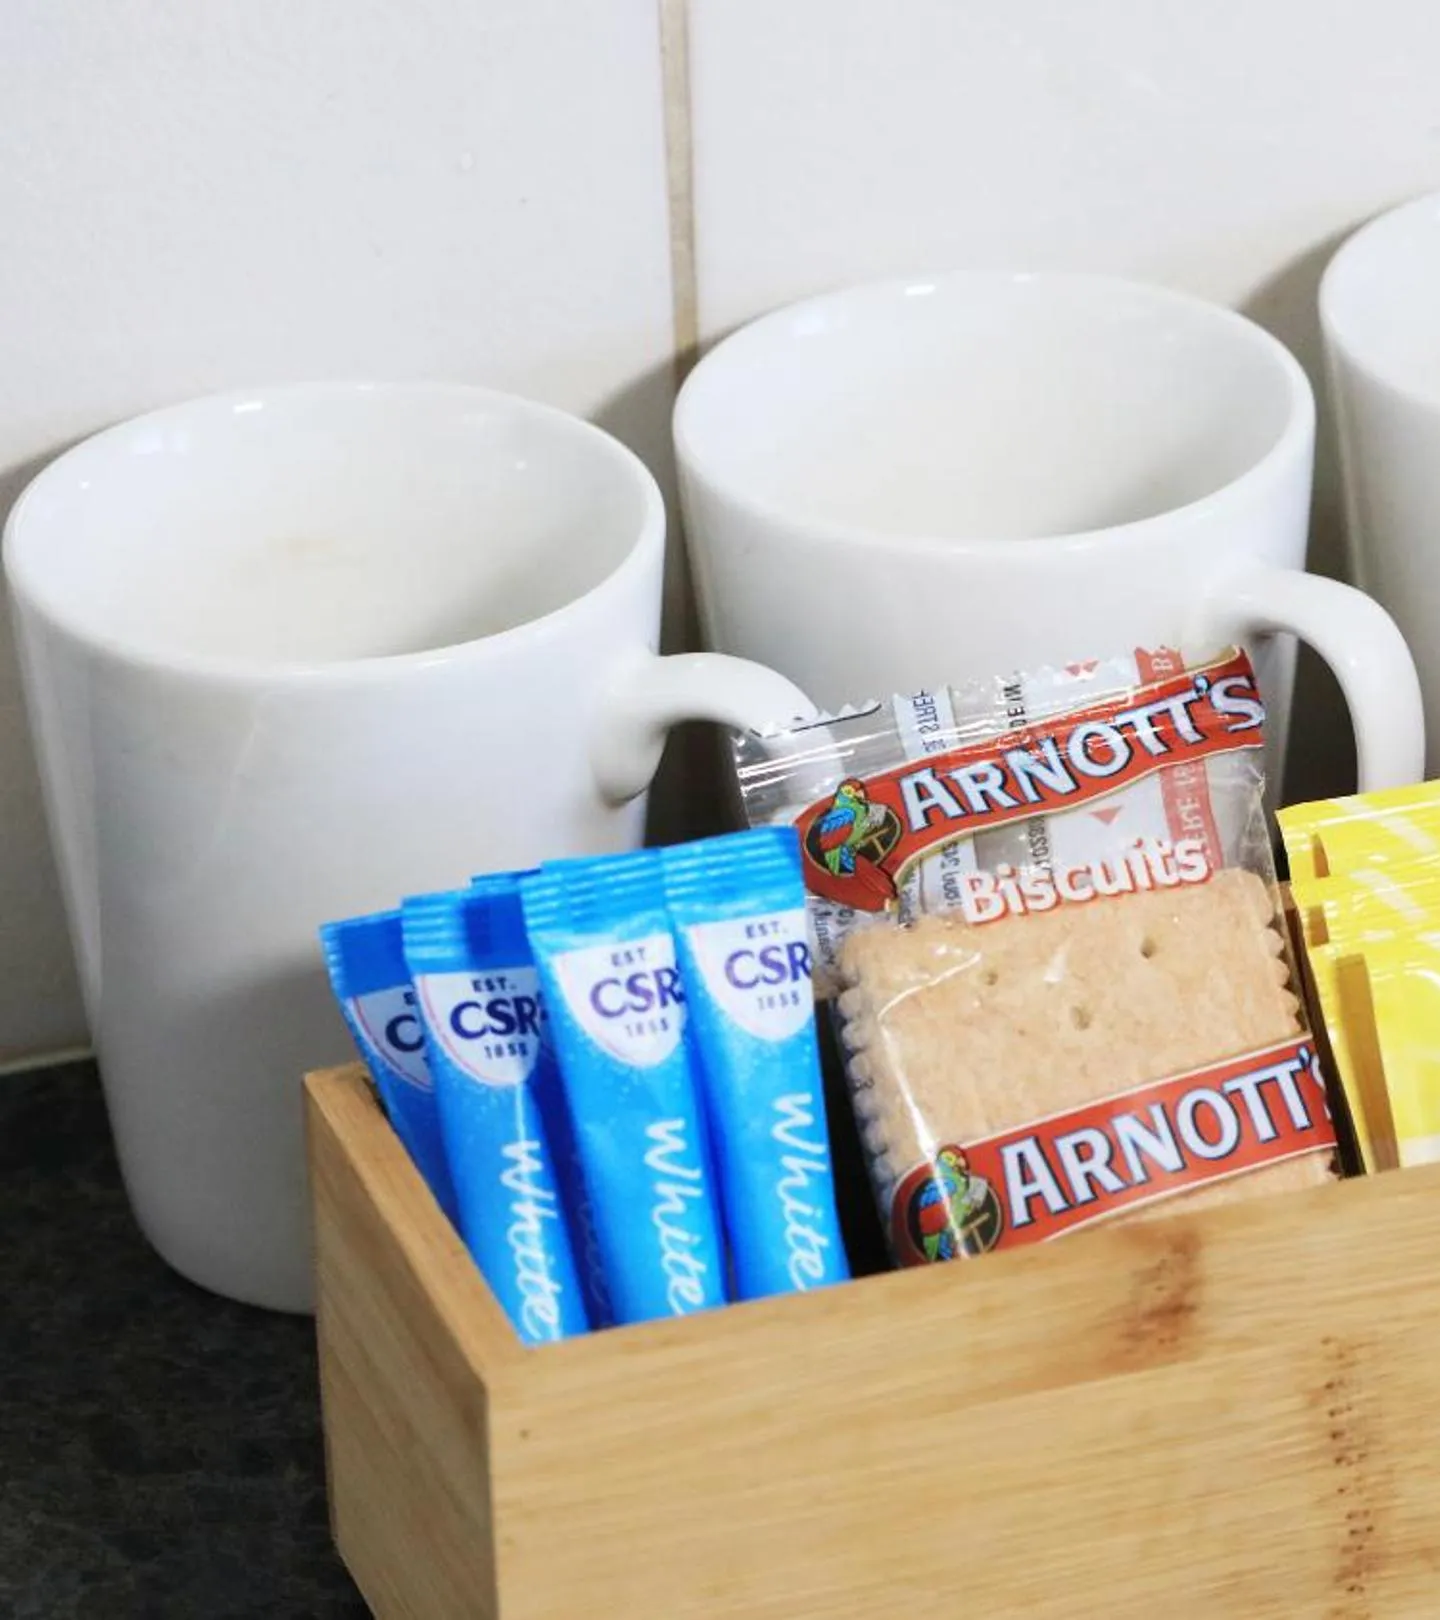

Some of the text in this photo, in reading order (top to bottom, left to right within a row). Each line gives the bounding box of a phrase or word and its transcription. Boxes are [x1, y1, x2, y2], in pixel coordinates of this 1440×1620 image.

[899, 674, 1267, 832] ARNOTT'S
[960, 838, 1213, 925] Biscuits
[471, 976, 518, 993] EST.
[591, 967, 688, 1019] CSR
[725, 941, 812, 989] CSR
[451, 995, 542, 1040] CSR
[644, 1117, 706, 1316] White
[771, 1092, 829, 1292] White
[499, 1139, 563, 1342] White
